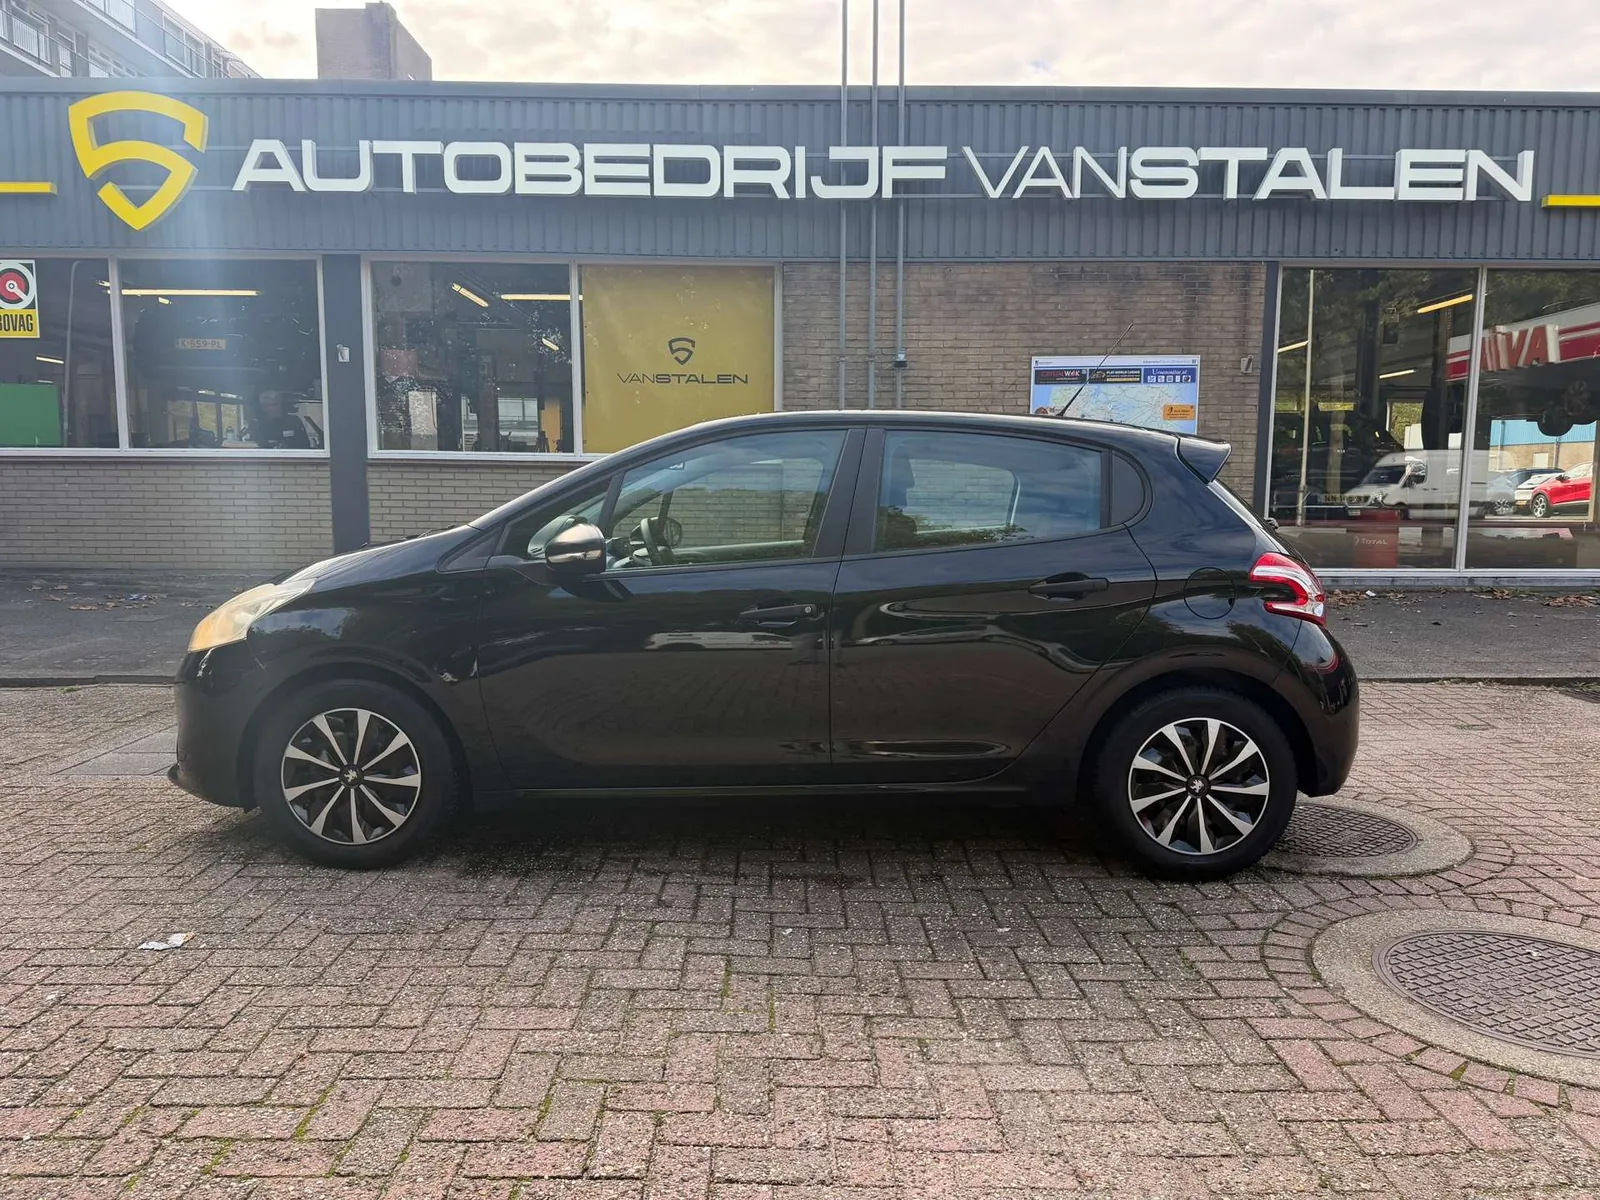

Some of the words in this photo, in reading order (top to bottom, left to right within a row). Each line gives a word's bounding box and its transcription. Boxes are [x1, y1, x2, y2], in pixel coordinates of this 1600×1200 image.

[232, 139, 948, 199] AUTOBEDRIJF
[961, 146, 1535, 202] VANSTALEN
[617, 373, 748, 384] VANSTALEN
